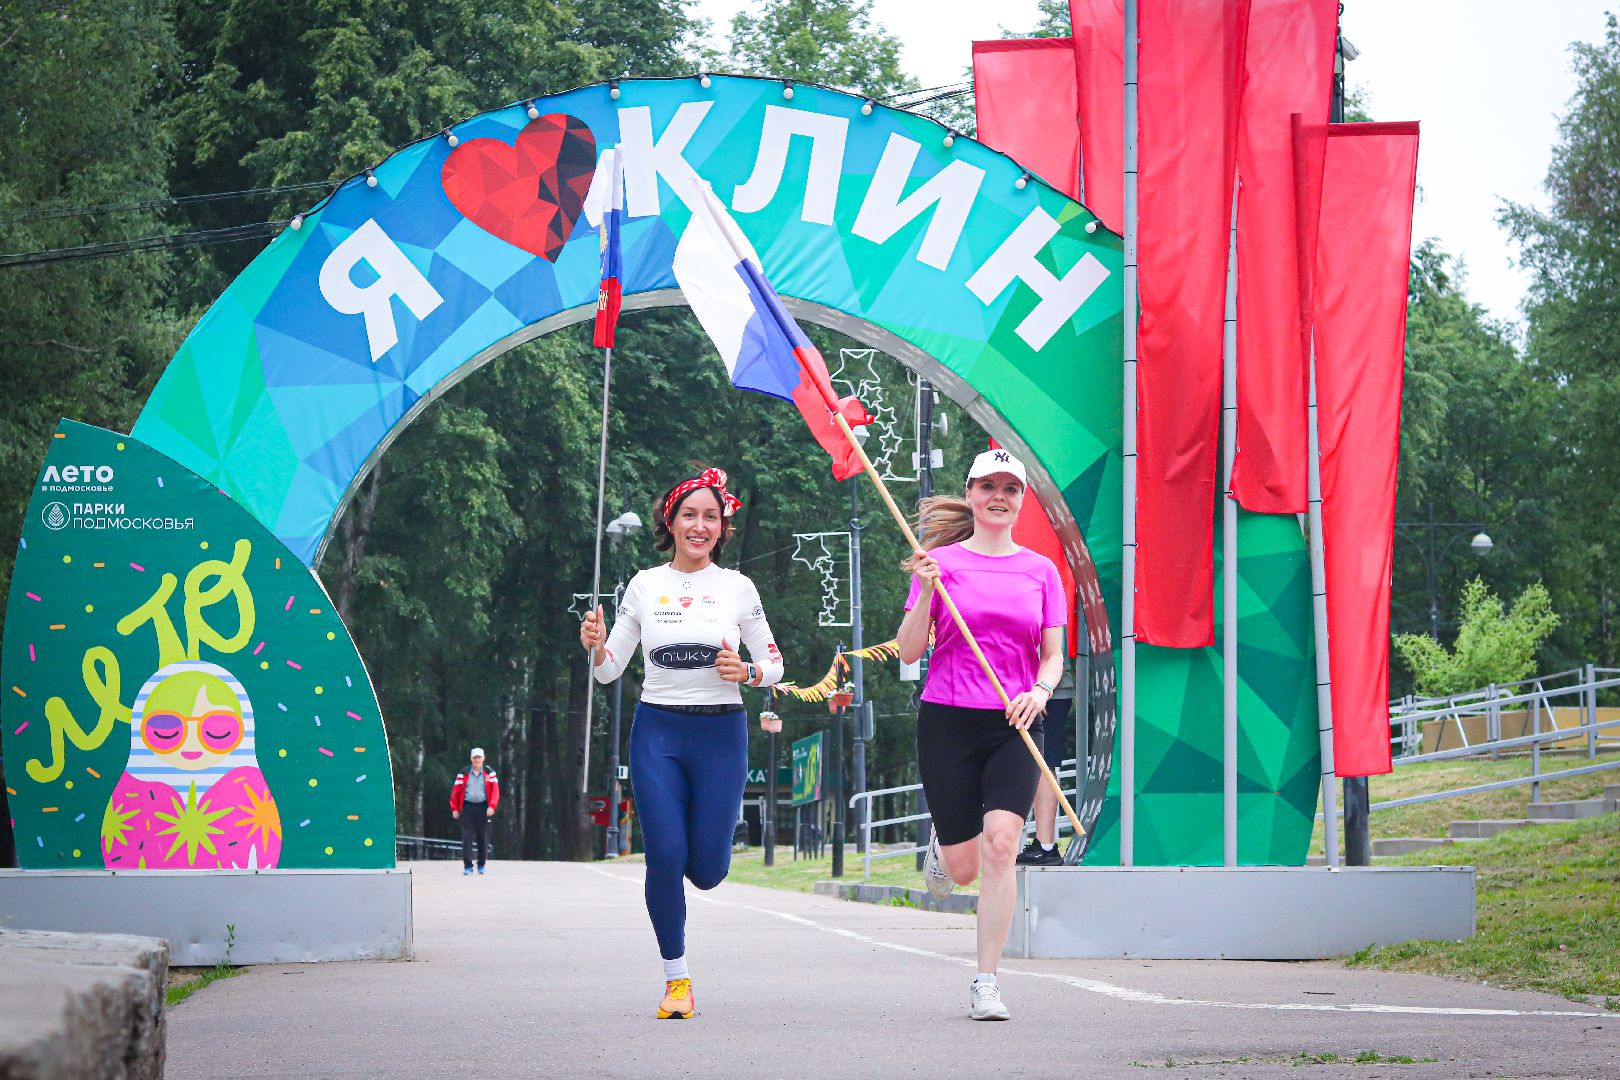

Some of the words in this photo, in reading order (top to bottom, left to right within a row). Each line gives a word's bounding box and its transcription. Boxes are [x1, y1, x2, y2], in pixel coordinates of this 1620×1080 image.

[319, 219, 445, 362] Я
[617, 100, 1111, 352] КЛИН
[73, 503, 125, 515] ПАРКИ
[73, 517, 194, 530] ПОДМОСКОВЬЯ
